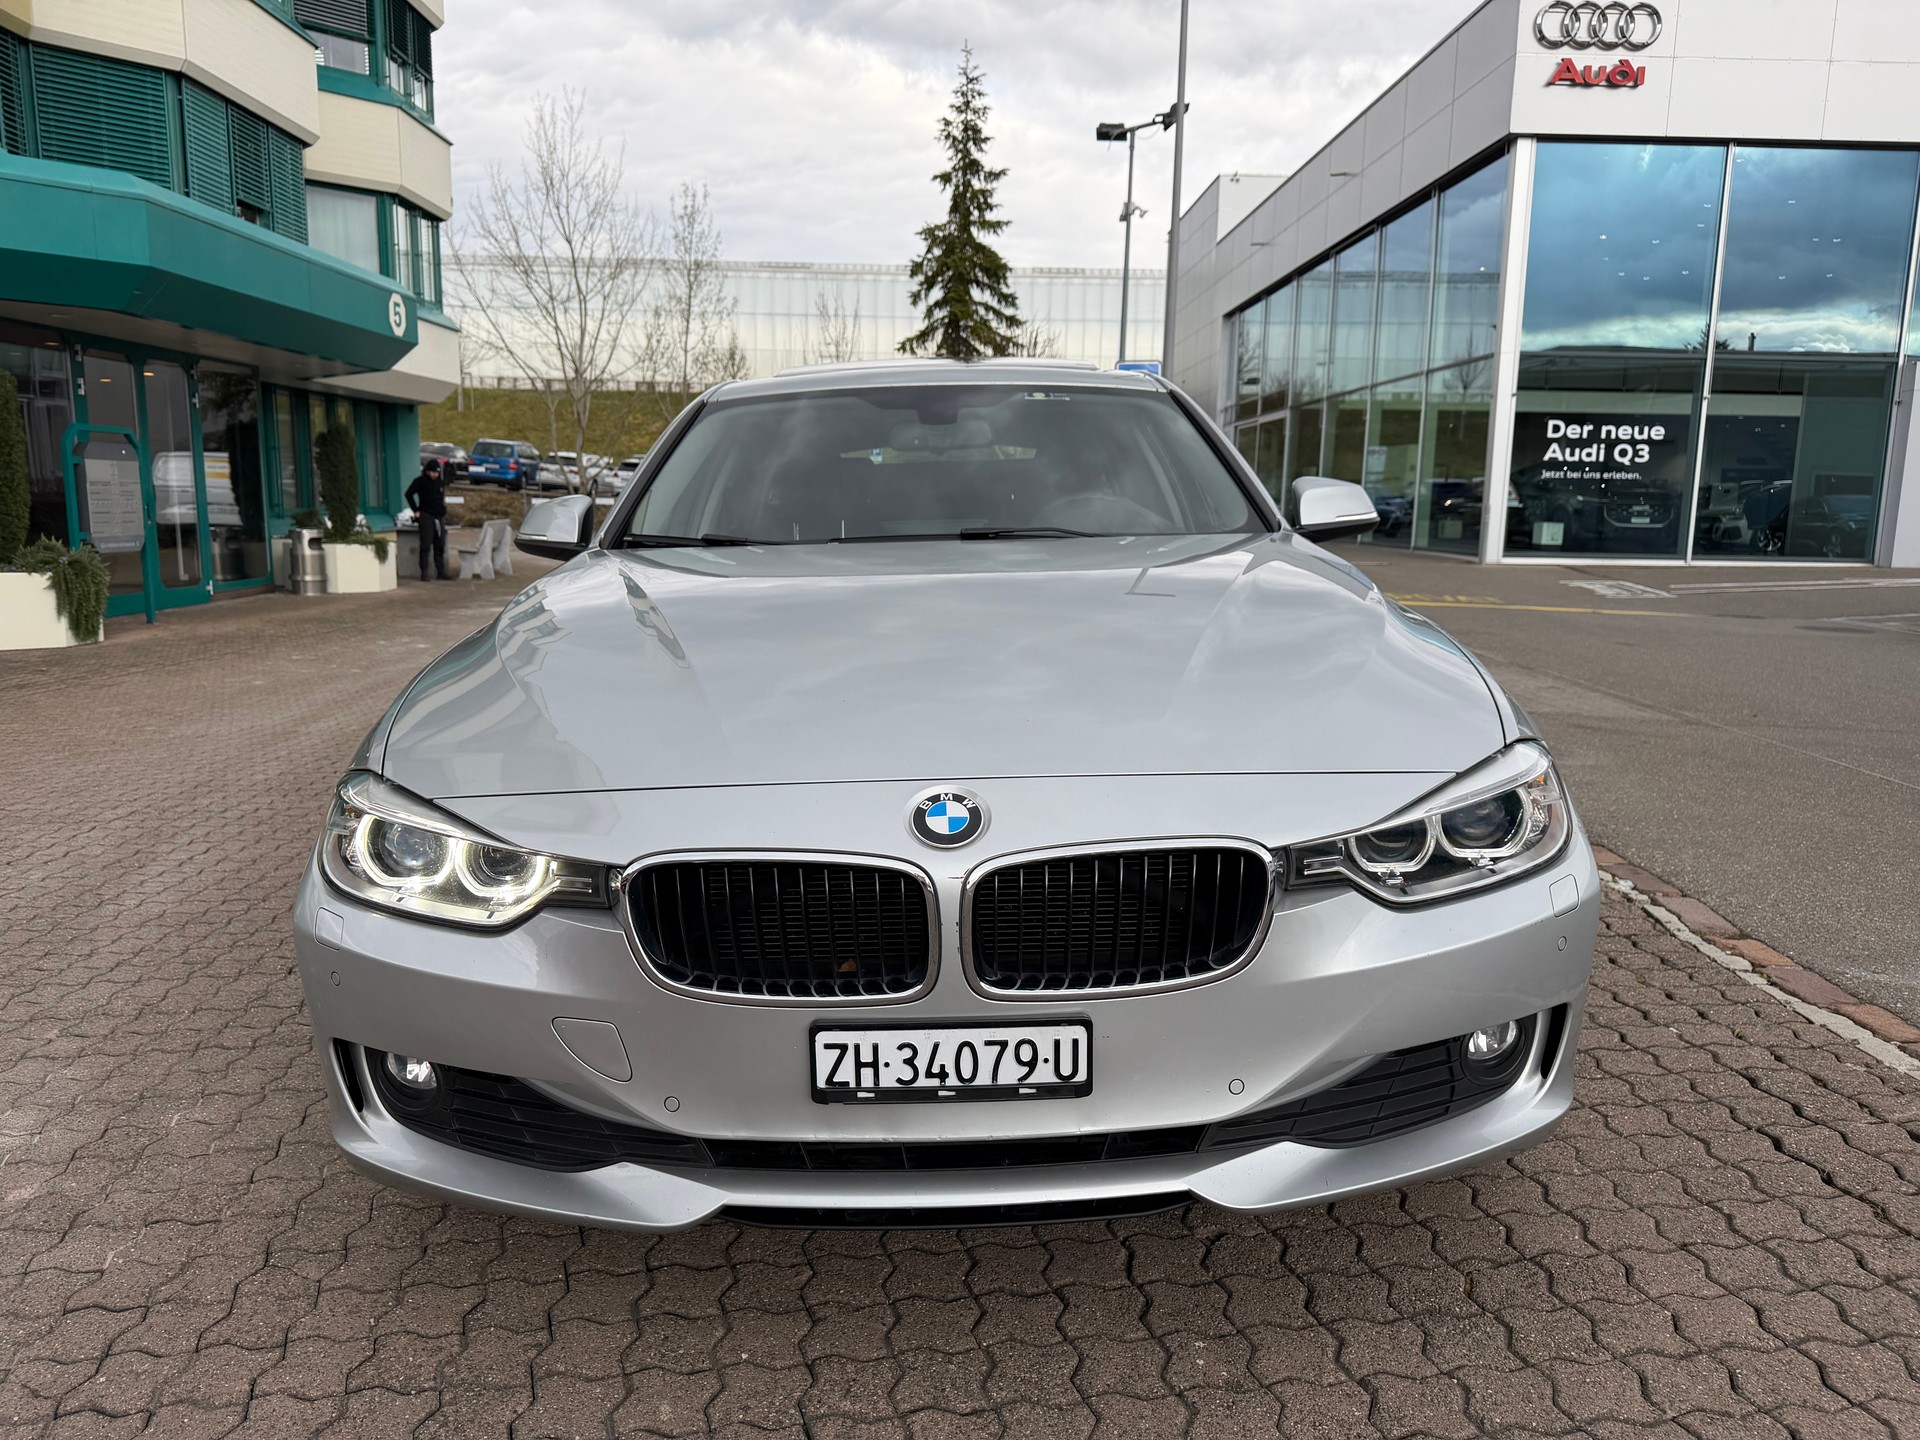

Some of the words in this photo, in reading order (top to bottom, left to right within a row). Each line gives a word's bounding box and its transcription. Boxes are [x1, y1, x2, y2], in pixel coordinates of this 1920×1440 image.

[1551, 57, 1646, 87] Audi
[394, 301, 402, 328] 5
[1547, 419, 1594, 439] Der
[1600, 424, 1665, 440] neue
[1543, 442, 1605, 462] Audi
[1613, 443, 1650, 466] Q3
[1541, 469, 1564, 480] Jetzt
[1566, 470, 1581, 479] bei
[1583, 471, 1600, 480] uns
[1602, 470, 1642, 480] erleben.
[919, 793, 976, 809] BMW
